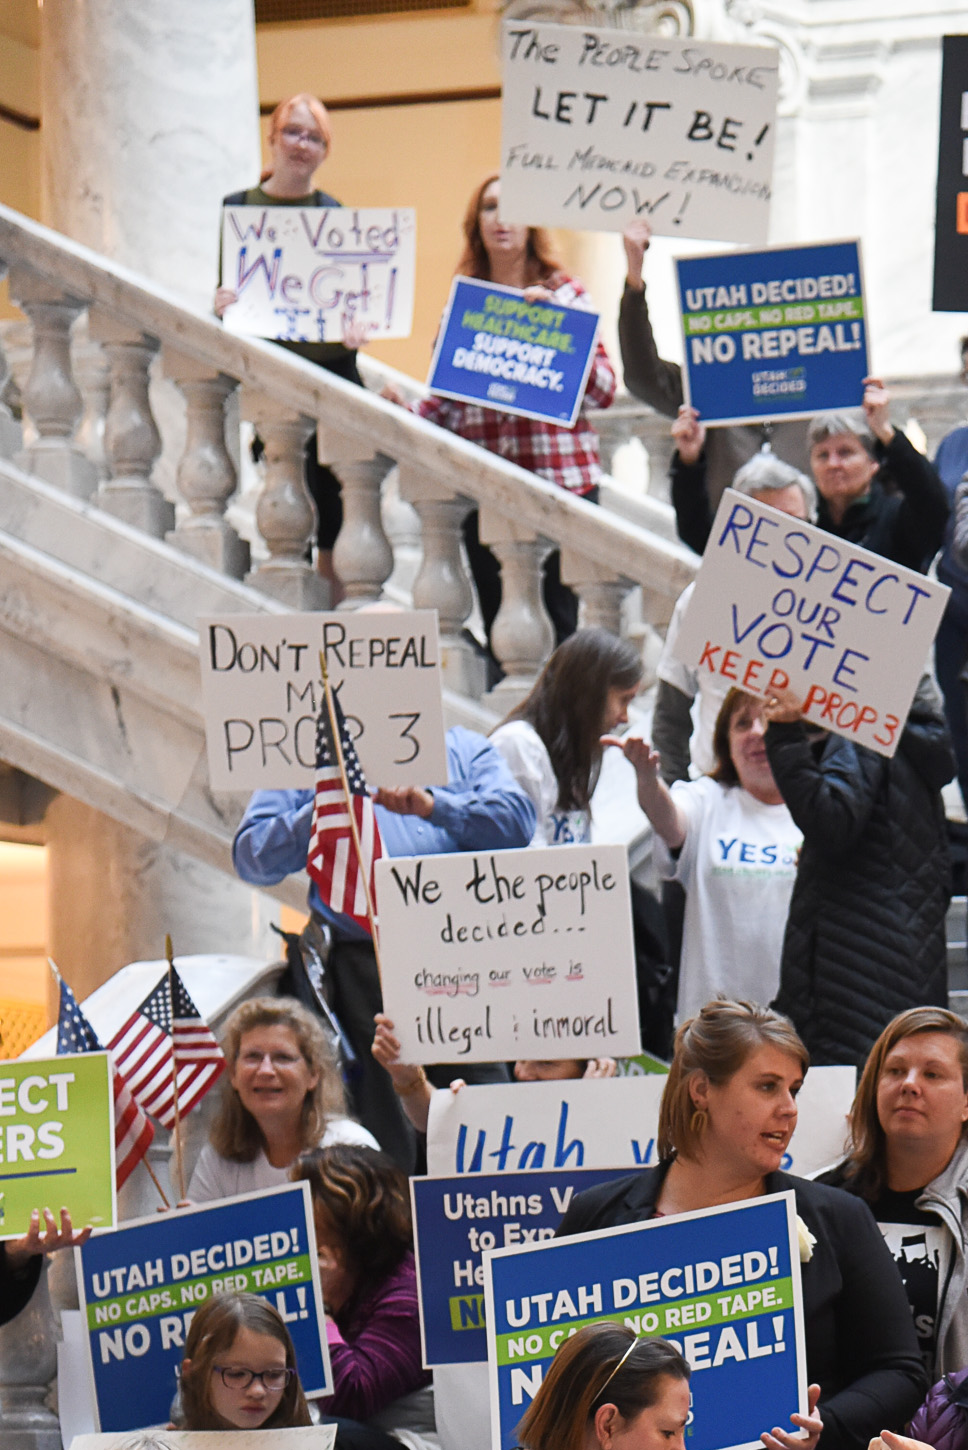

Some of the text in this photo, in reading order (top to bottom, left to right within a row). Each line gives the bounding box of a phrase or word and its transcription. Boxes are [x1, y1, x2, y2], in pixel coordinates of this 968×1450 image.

[510, 30, 558, 63] The
[674, 49, 778, 89] SPOKE
[533, 86, 769, 160] LET IT BE!
[506, 144, 559, 169] FULL
[228, 210, 399, 251] We Voted
[237, 248, 303, 303] We
[686, 273, 855, 310] UTAH DECIDED!
[485, 295, 566, 328] SUPPORT
[689, 316, 711, 331] NO
[760, 308, 782, 324] NO
[473, 332, 557, 367] SUPPORT
[692, 322, 861, 365] NO REPEAL!
[452, 347, 564, 392] DEMOCRACY.
[718, 504, 931, 625] RESPECT
[772, 588, 841, 639] OUR
[698, 641, 790, 695] KEEP
[732, 603, 870, 693] VOTE
[388, 712, 421, 764] 3
[718, 838, 777, 864] YES
[391, 856, 616, 915] We the people
[415, 960, 582, 997] changing our vote is
[415, 1005, 492, 1054] illegal
[456, 1100, 585, 1173] Utah
[443, 1190, 543, 1220] Utahns
[468, 1222, 556, 1252] to Exp
[92, 1228, 300, 1298] UTAH DECIDED!
[506, 1284, 602, 1328] UTAH
[612, 1246, 779, 1309] DECIDED!
[95, 1262, 303, 1324] NO CAPS. NO RED TAPE.
[99, 1323, 150, 1365] NO
[507, 1335, 543, 1358] NO
[624, 1313, 659, 1334] NO
[665, 1302, 712, 1328] RED
[717, 1286, 783, 1317] TAPE.
[510, 1364, 543, 1406] N
